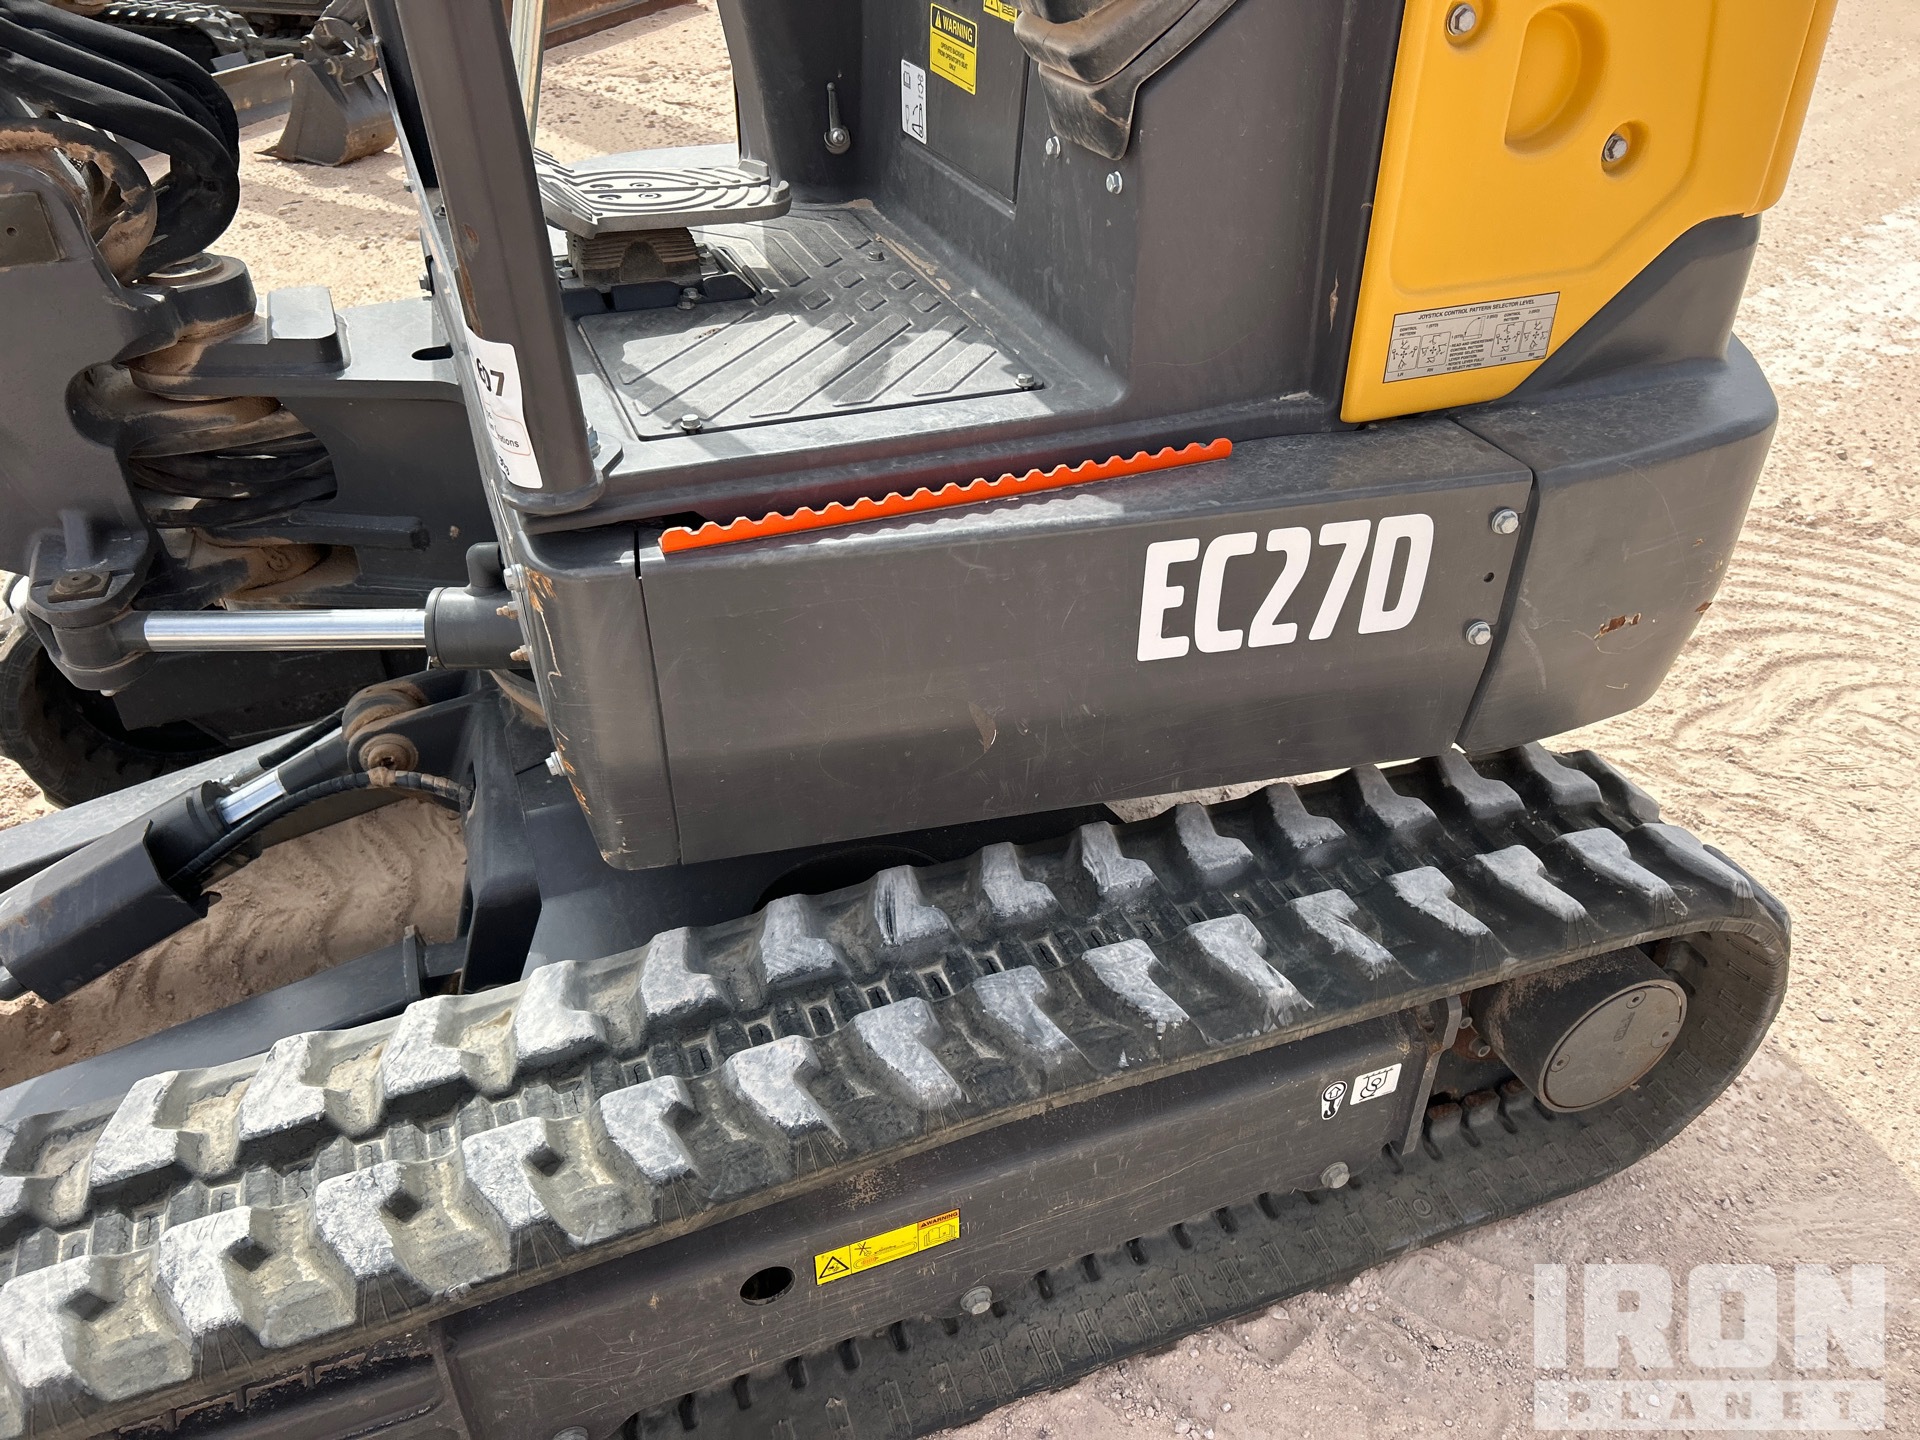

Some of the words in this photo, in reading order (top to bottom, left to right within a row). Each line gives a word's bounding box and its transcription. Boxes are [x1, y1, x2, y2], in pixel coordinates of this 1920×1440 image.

[942, 15, 973, 43] WARNING
[1418, 312, 1443, 320] JOYSTICK
[1444, 308, 1468, 316] CONTROL
[1469, 305, 1492, 313] PATTERN
[1492, 301, 1519, 309] SELECTOR
[1137, 513, 1434, 662] EC27D
[926, 1211, 958, 1226] WARNING
